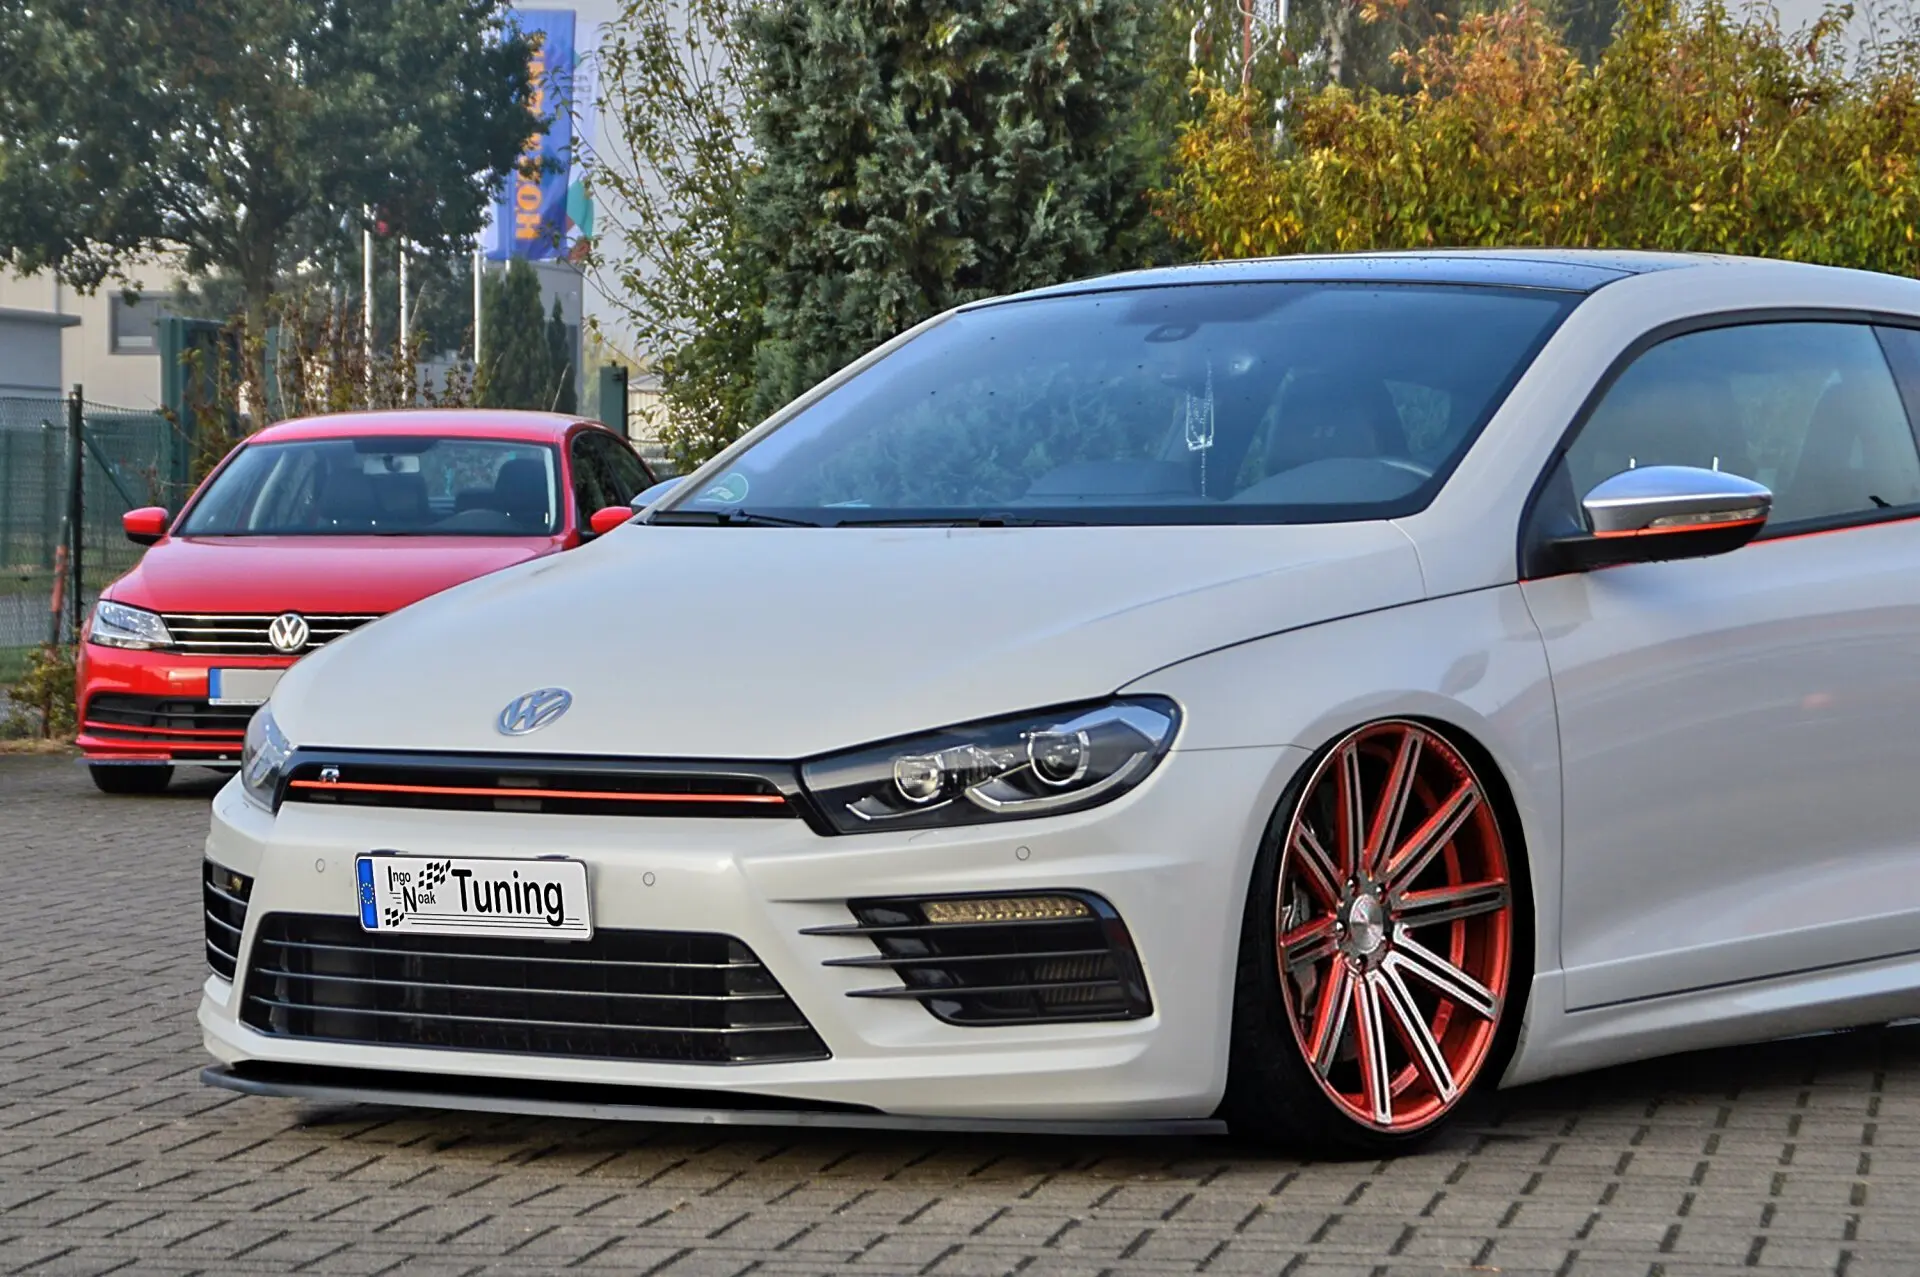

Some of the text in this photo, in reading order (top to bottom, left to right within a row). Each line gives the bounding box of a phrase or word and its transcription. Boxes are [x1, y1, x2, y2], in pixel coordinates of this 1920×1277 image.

[387, 865, 411, 891] Ingo
[402, 886, 436, 912] Noak
[451, 868, 564, 926] Tuning
